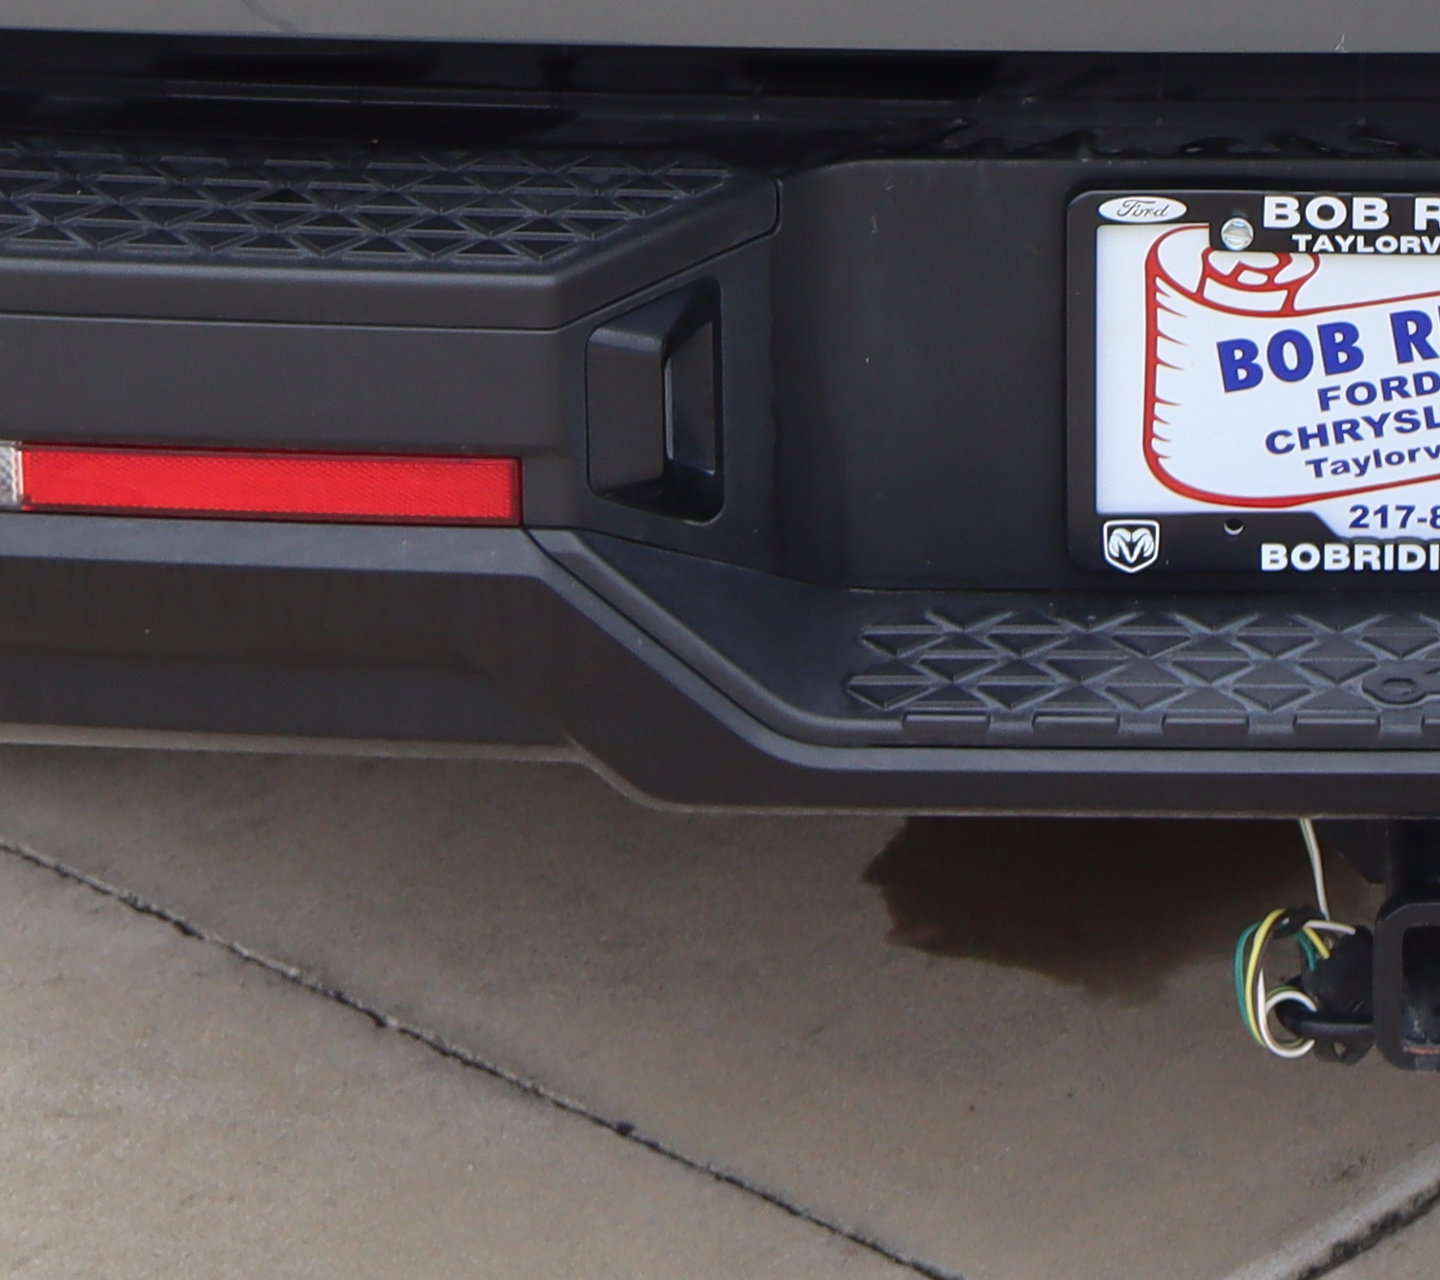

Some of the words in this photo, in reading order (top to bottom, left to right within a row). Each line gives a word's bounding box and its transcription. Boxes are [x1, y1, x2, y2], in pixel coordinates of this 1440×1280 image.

[1115, 197, 1170, 218] Ford
[1263, 195, 1391, 231] BOB
[1216, 321, 1365, 394] BOB
